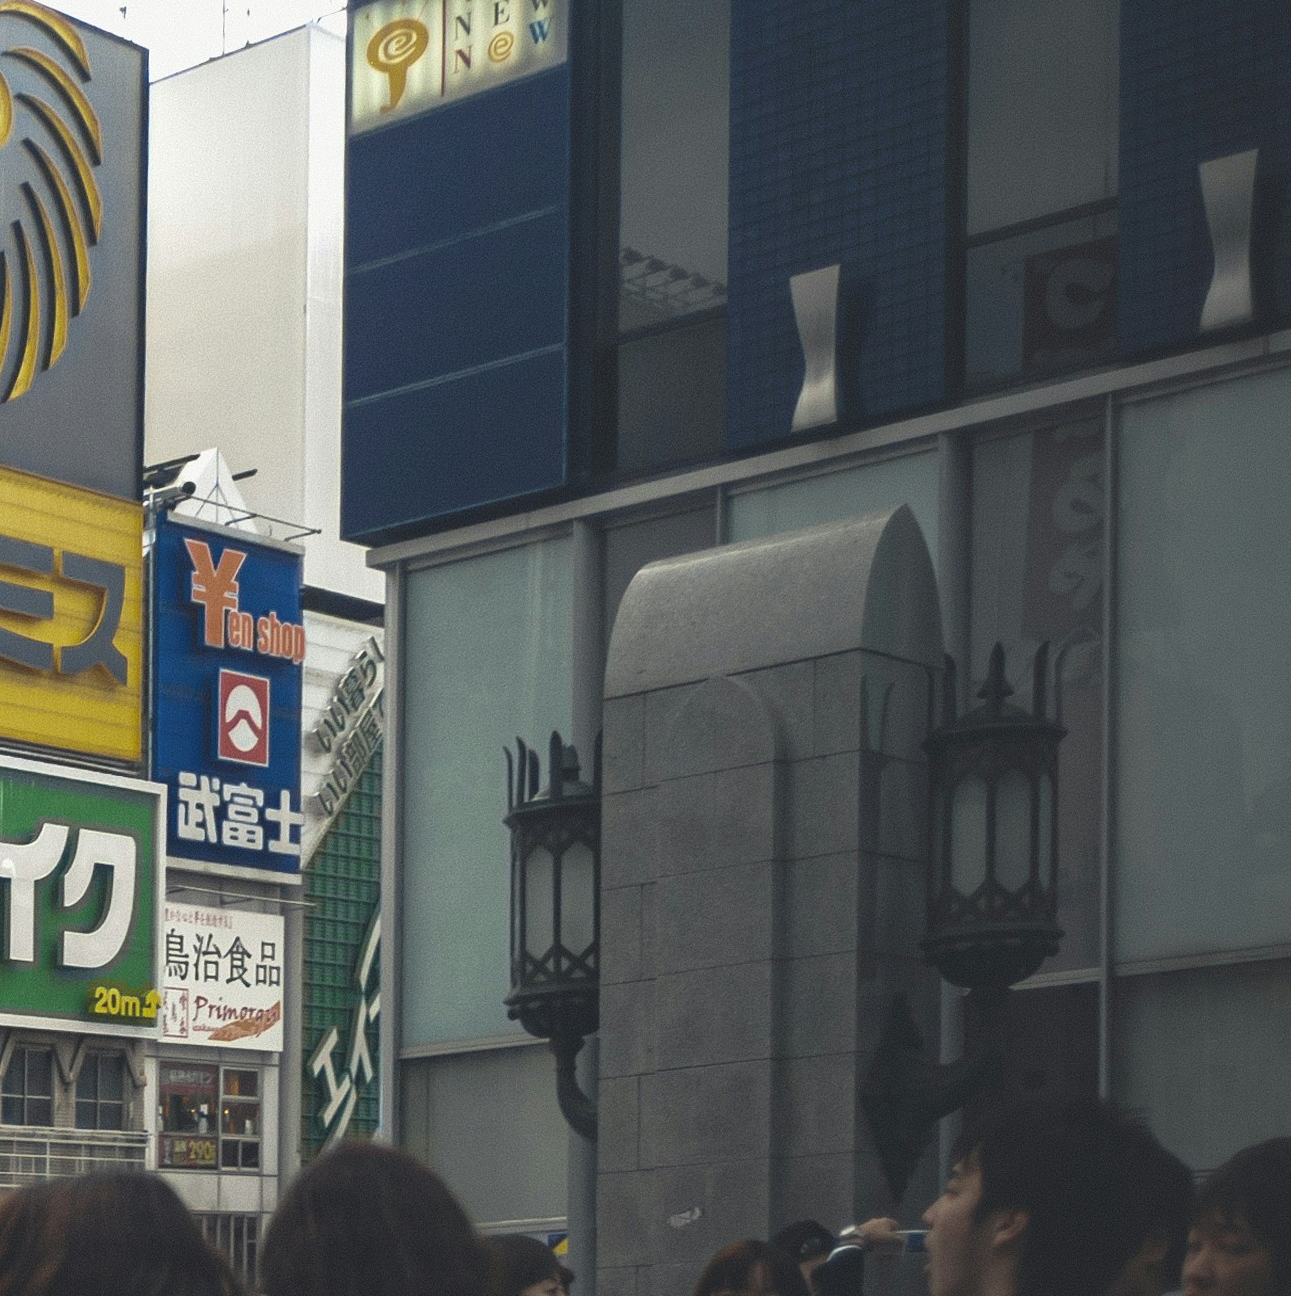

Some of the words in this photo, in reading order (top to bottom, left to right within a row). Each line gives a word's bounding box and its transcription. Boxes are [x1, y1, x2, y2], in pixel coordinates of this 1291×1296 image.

[257, 611, 307, 665] shop
[177, 770, 306, 857] 武富士
[165, 928, 281, 988] 鳥治食品
[94, 986, 142, 1017] 20m
